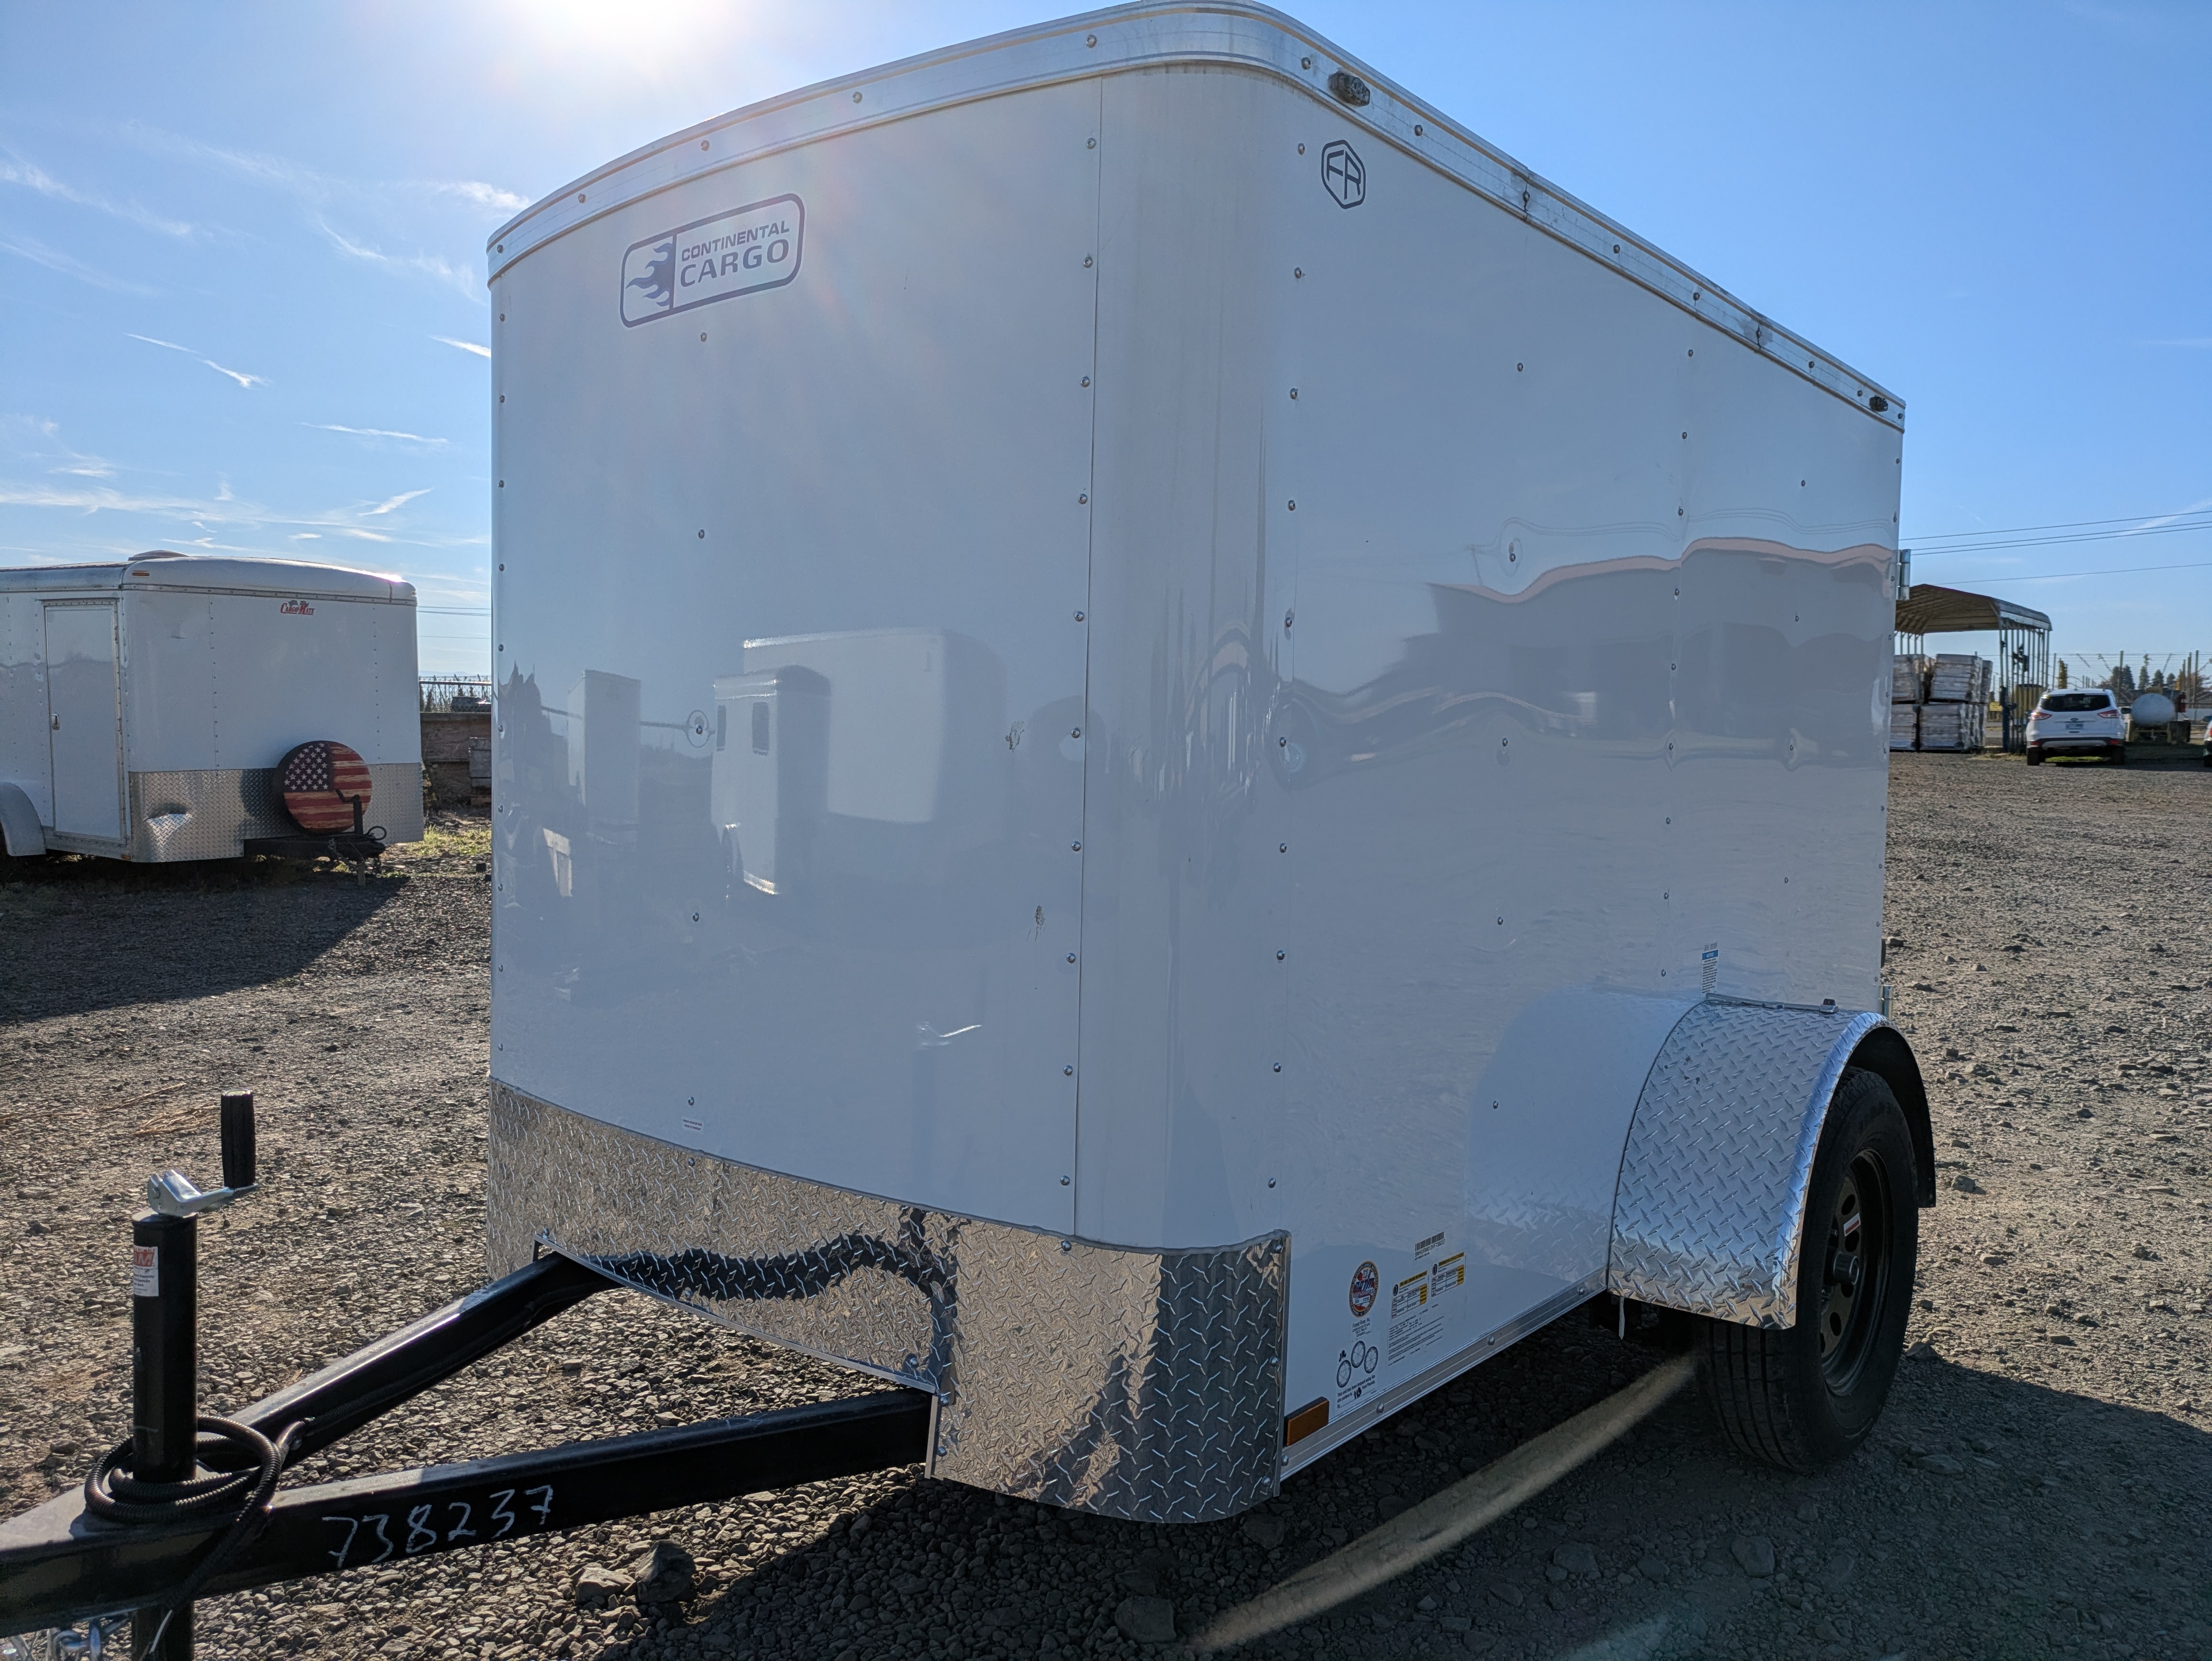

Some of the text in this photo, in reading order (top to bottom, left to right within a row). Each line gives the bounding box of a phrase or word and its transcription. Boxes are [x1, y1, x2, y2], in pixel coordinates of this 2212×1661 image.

[680, 239, 789, 287] CARGO
[681, 221, 790, 262] CONTINENTAL
[321, 1484, 554, 1569] 738237
